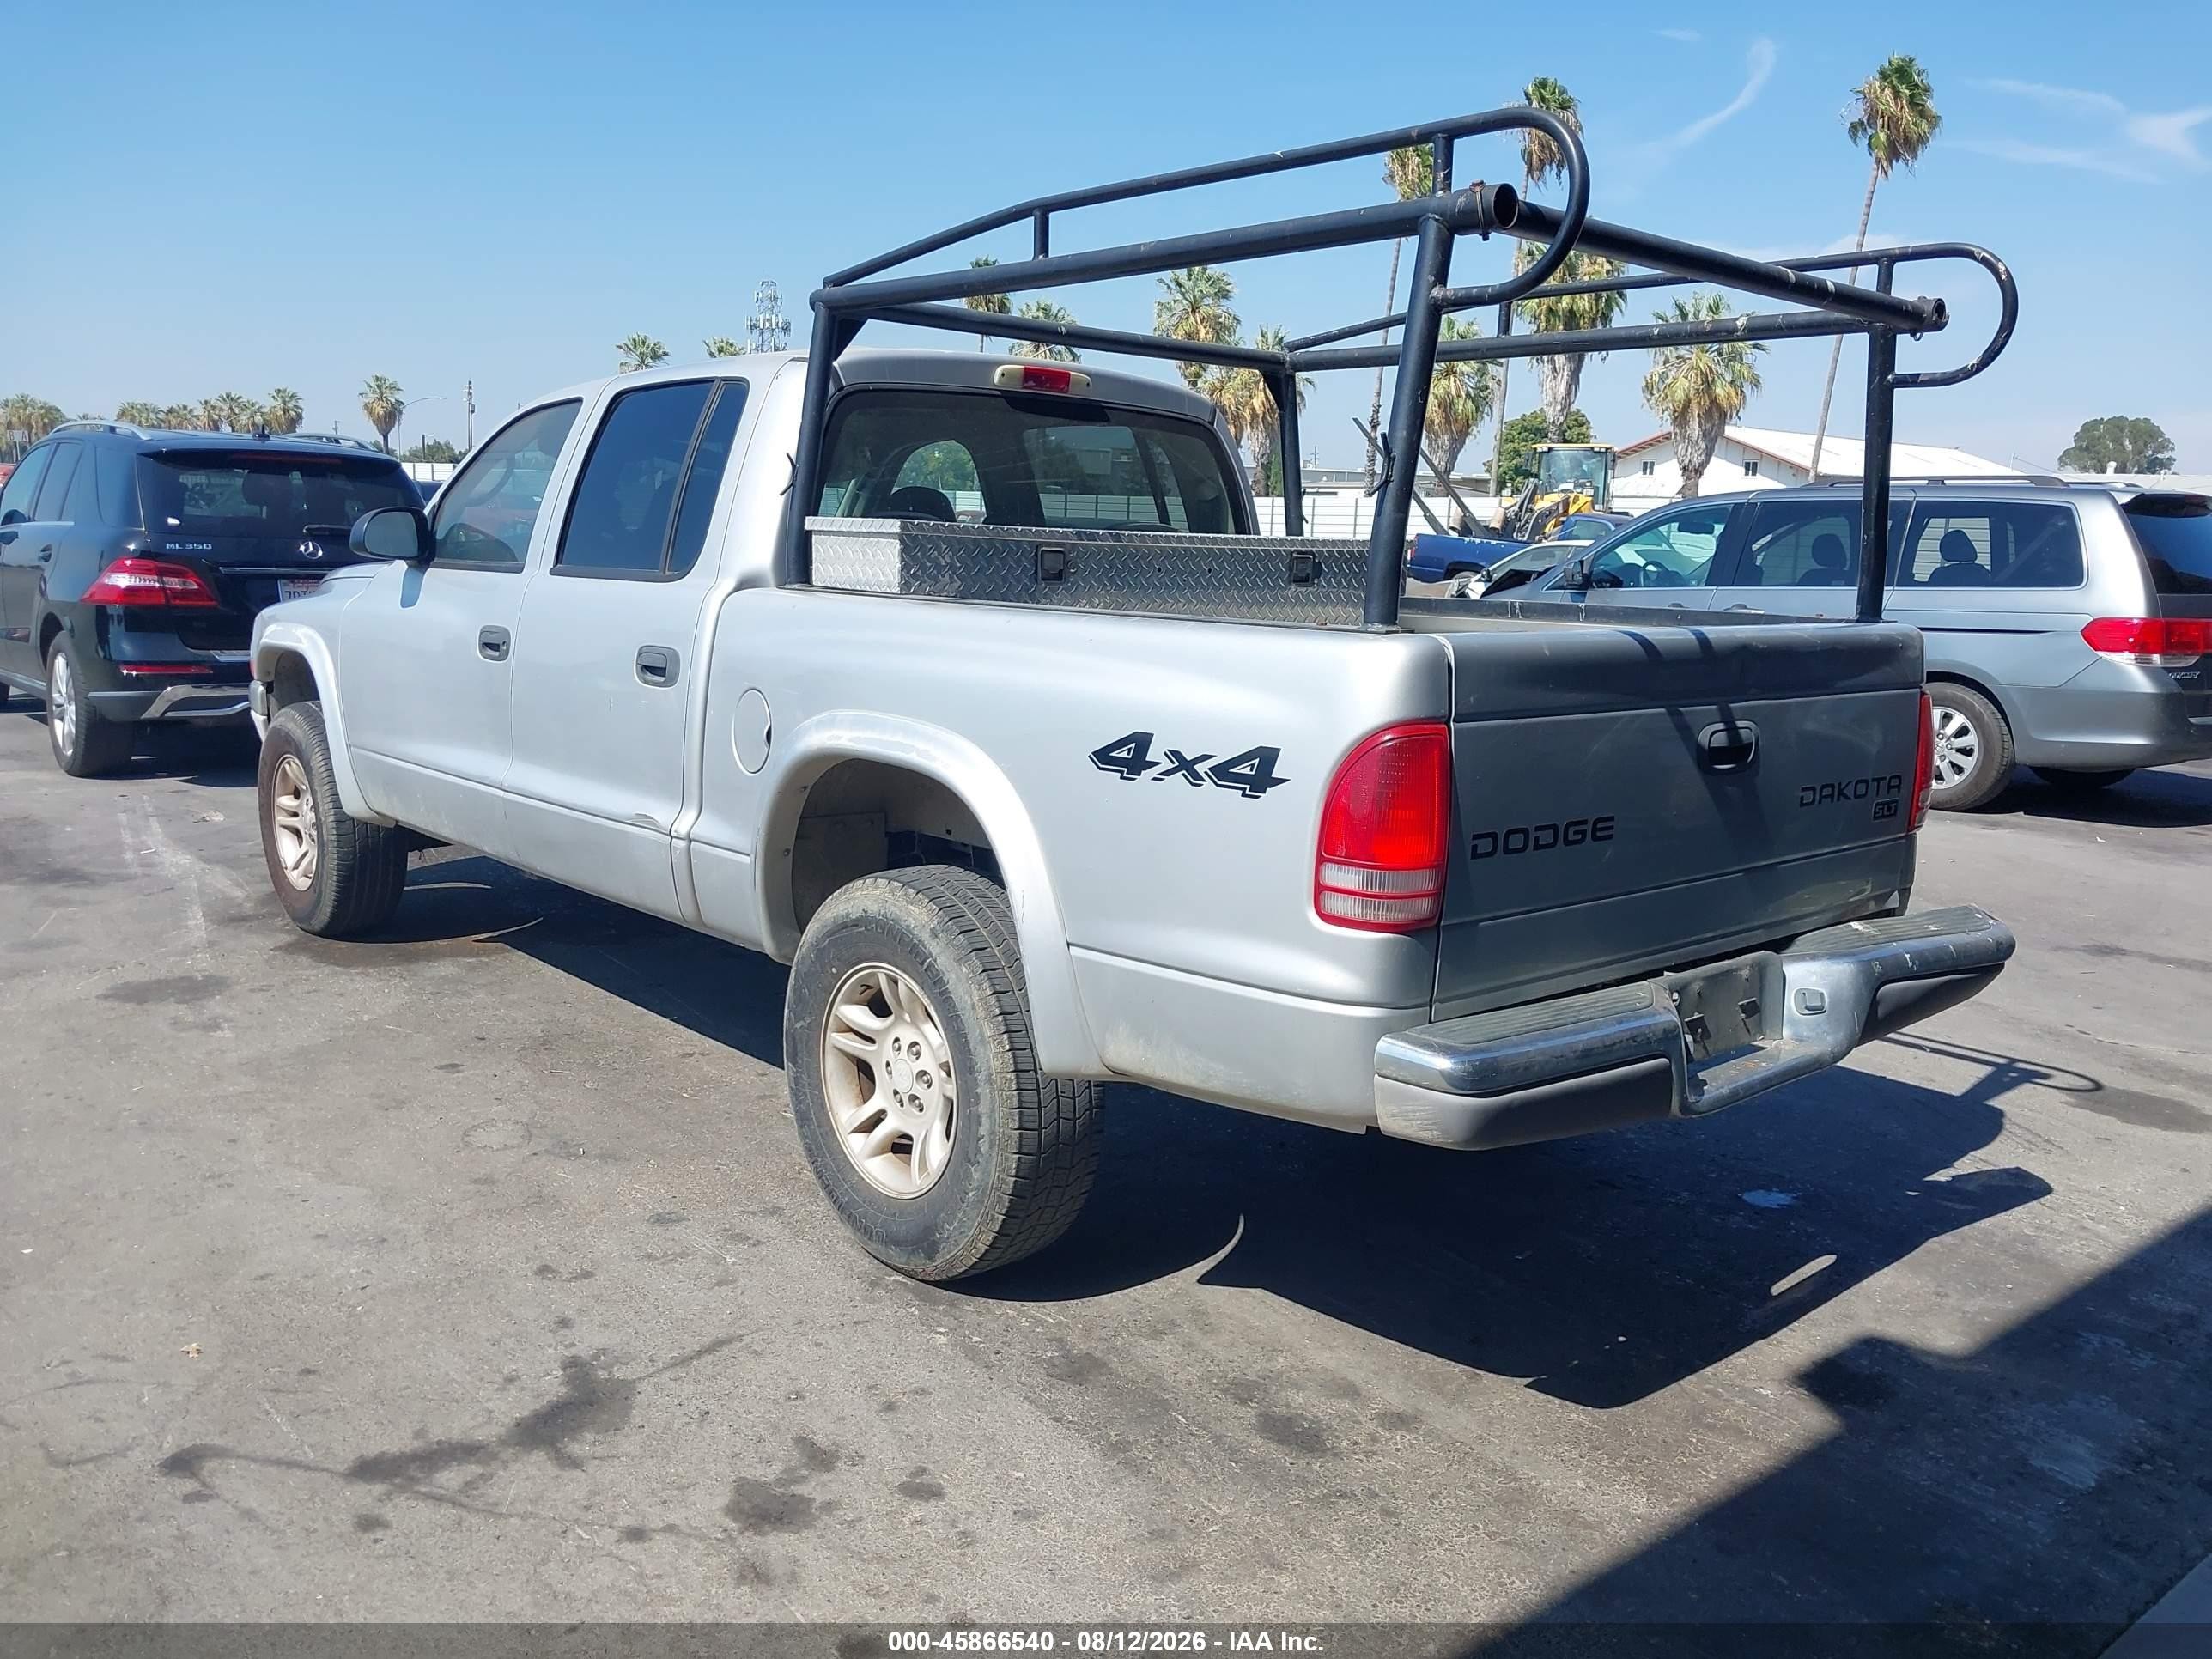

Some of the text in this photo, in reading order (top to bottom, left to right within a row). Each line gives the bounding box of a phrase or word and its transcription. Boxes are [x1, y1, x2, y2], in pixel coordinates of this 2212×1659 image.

[1088, 731, 1291, 799] 4x4
[1799, 775, 1902, 808] DAKOTA
[1875, 802, 1897, 818] SLT
[1470, 816, 1615, 860] DODGE
